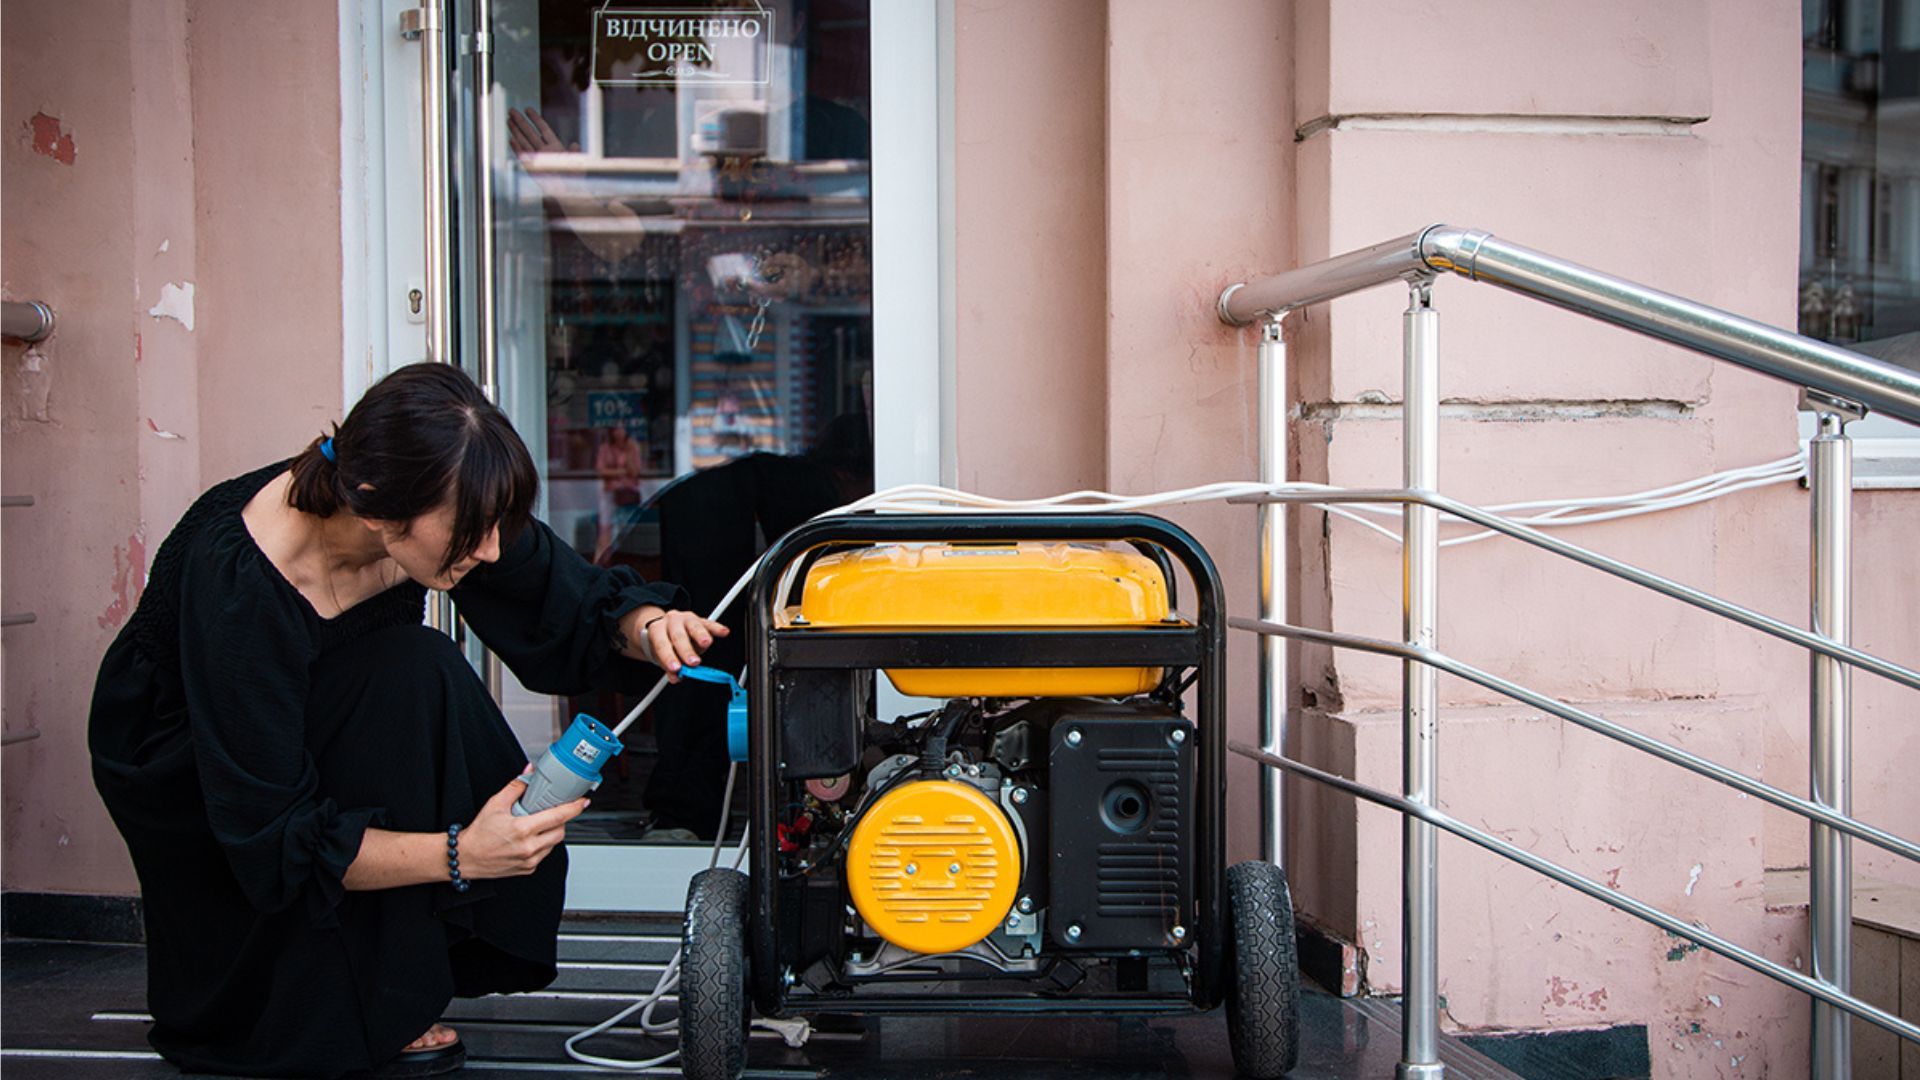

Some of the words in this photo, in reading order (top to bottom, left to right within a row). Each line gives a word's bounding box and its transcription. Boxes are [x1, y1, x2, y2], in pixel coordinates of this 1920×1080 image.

[606, 18, 761, 41] ВІДЧИНЕНО
[647, 43, 716, 62] OPEN
[594, 400, 632, 416] 10%
